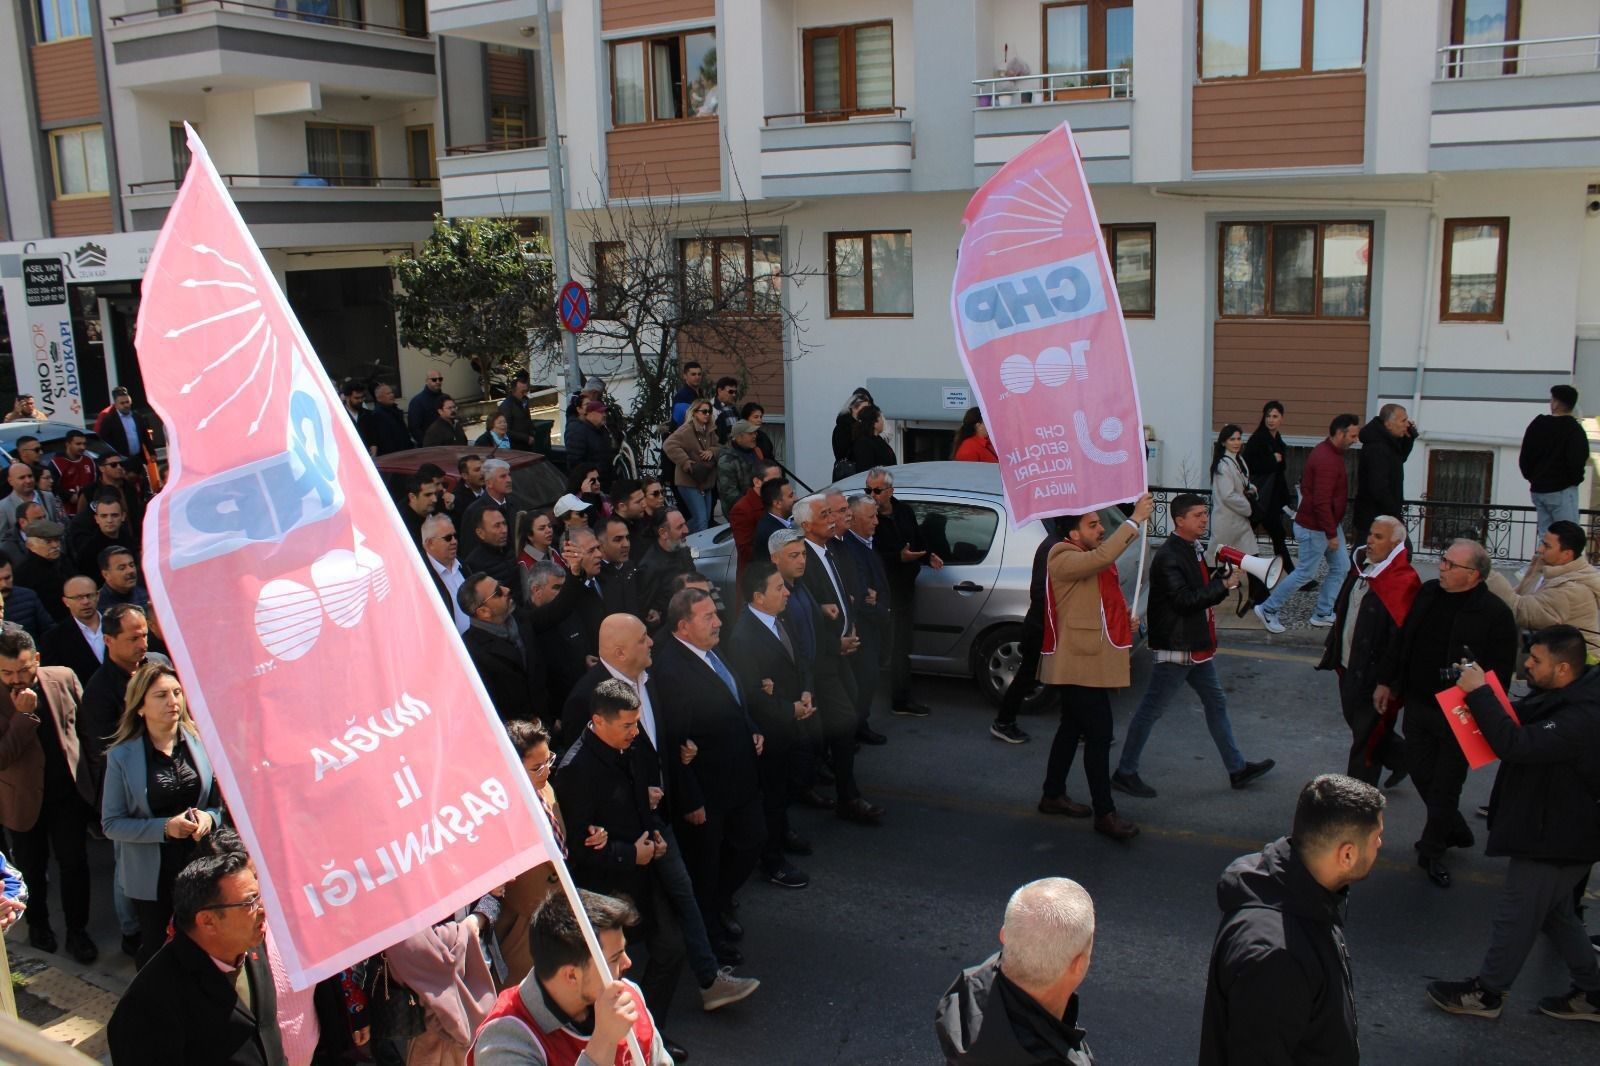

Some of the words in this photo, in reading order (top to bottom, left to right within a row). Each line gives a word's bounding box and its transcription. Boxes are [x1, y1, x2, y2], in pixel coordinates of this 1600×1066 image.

[25, 264, 44, 273] ASEL
[44, 263, 62, 272] YAPI
[31, 274, 58, 284] İNŞAAT
[32, 323, 55, 416] VARIODOR
[59, 320, 80, 396] ADOKAPI
